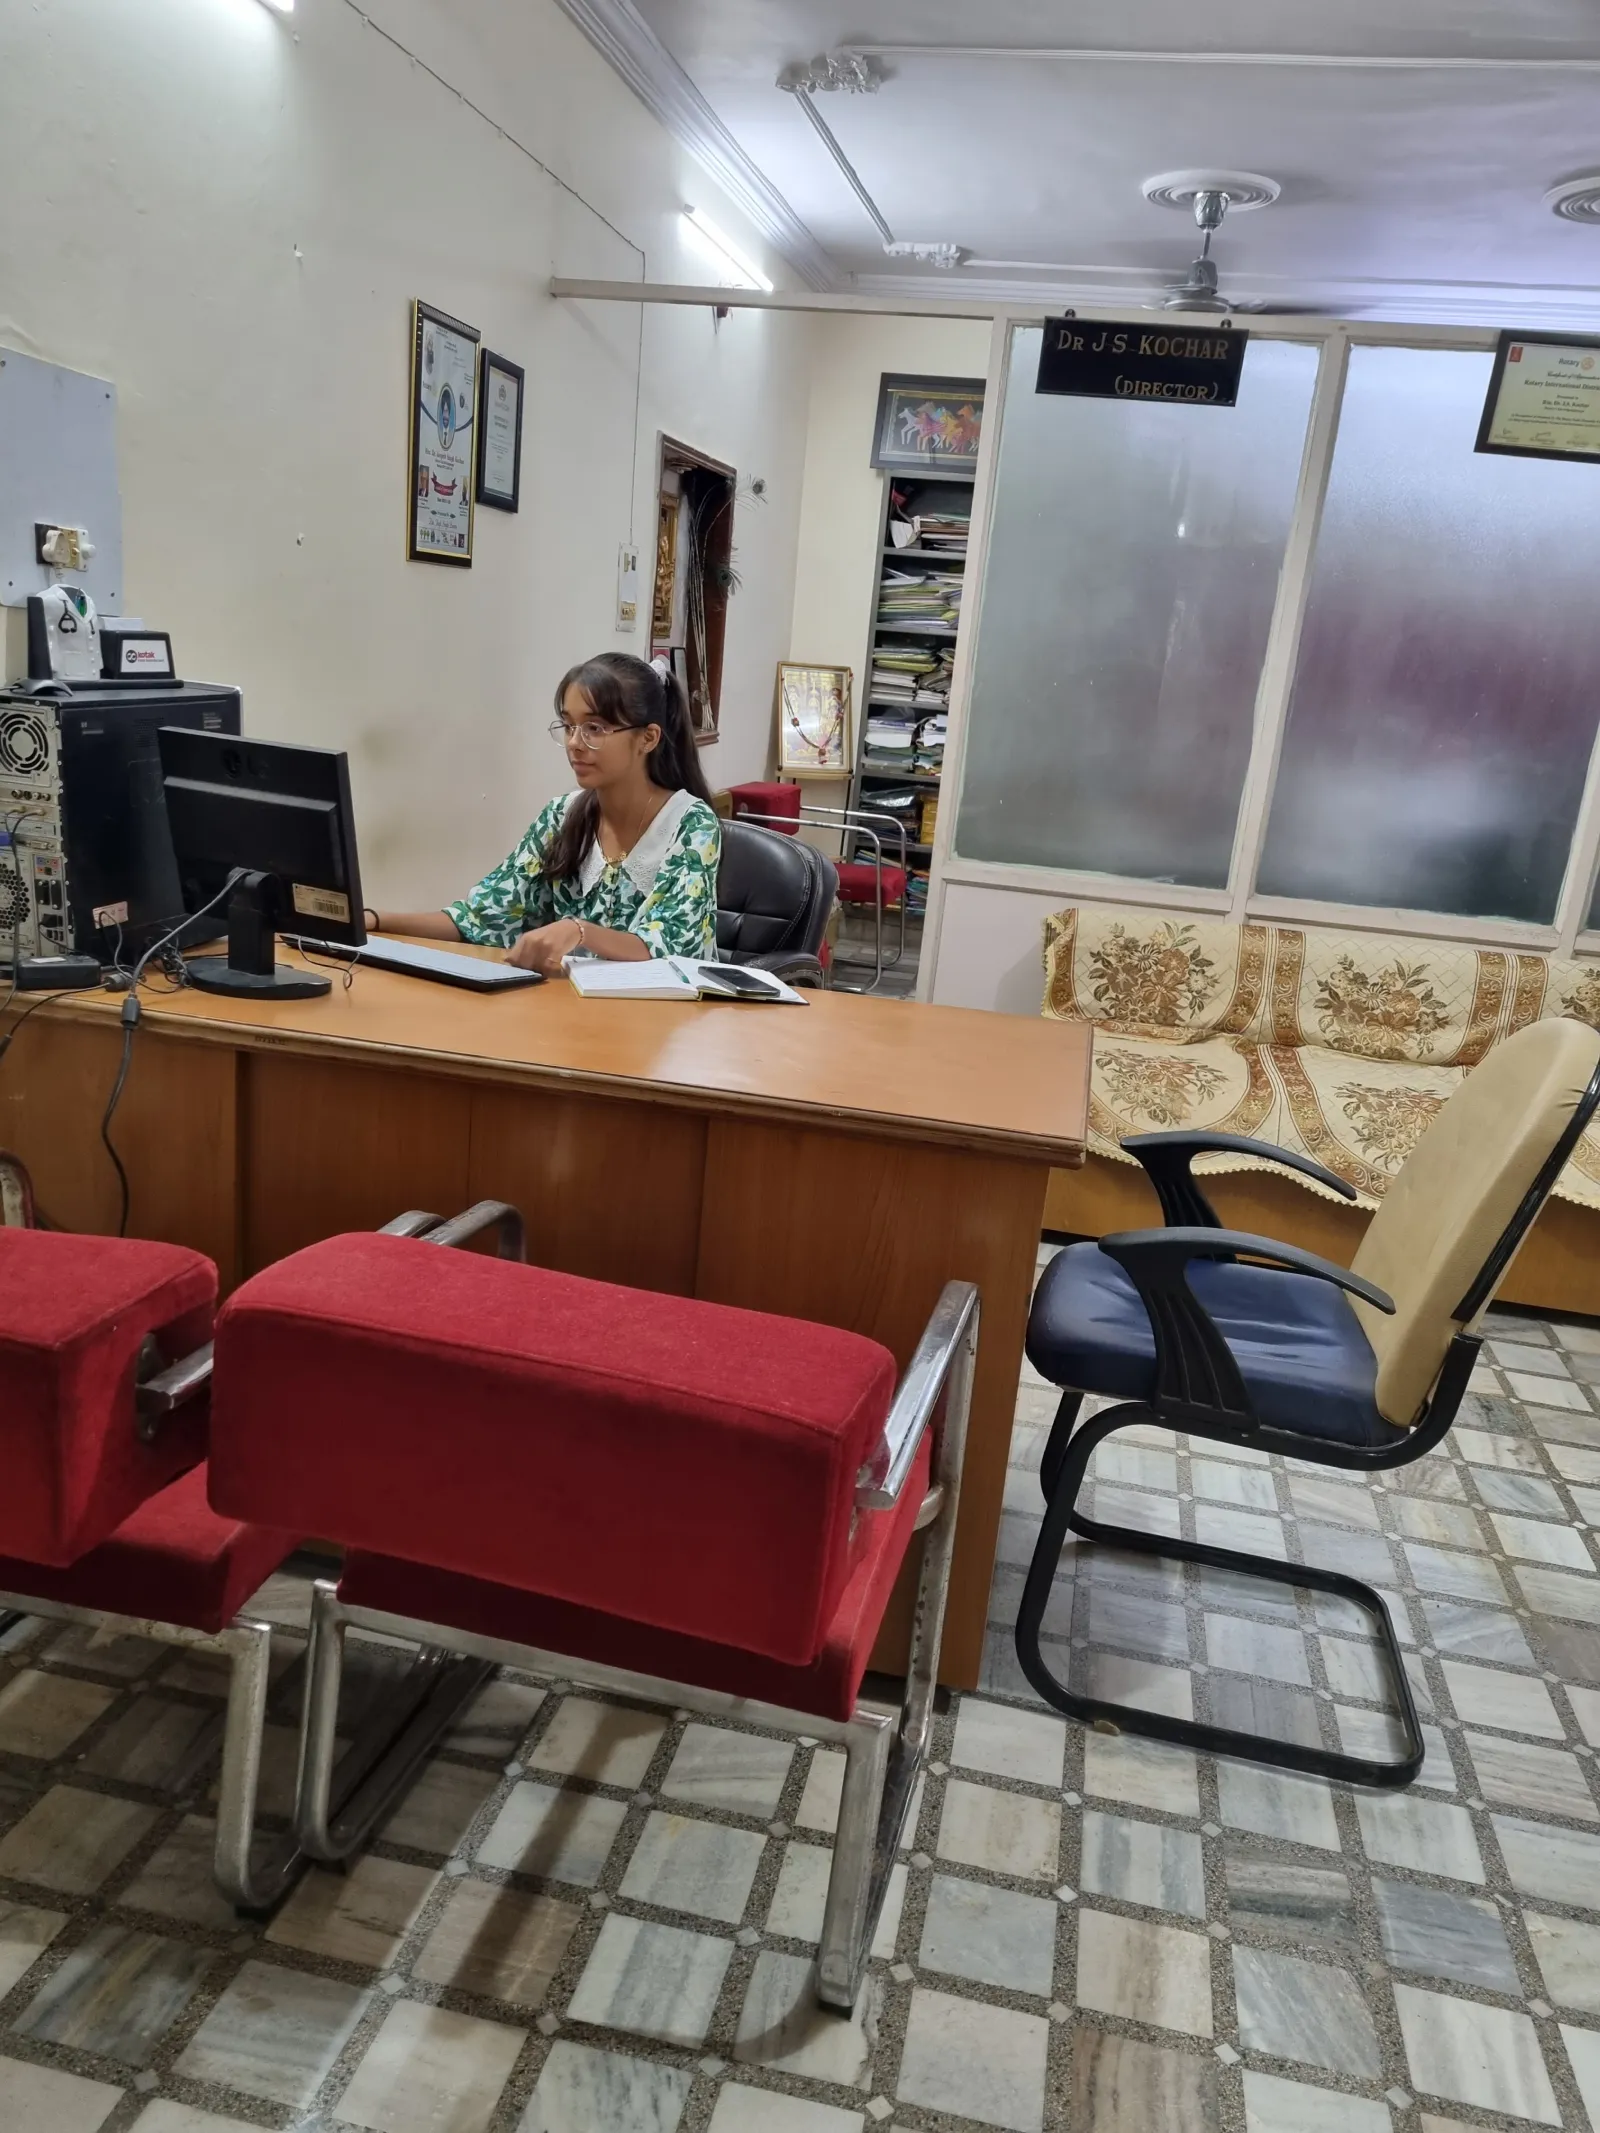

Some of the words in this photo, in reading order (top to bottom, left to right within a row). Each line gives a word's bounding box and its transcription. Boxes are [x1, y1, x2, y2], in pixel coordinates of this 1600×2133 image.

[1092, 332, 1108, 352] J
[1112, 334, 1128, 354] S
[1138, 335, 1229, 360] KOCHAR
[1114, 375, 1219, 400] (DIRECTOR)
